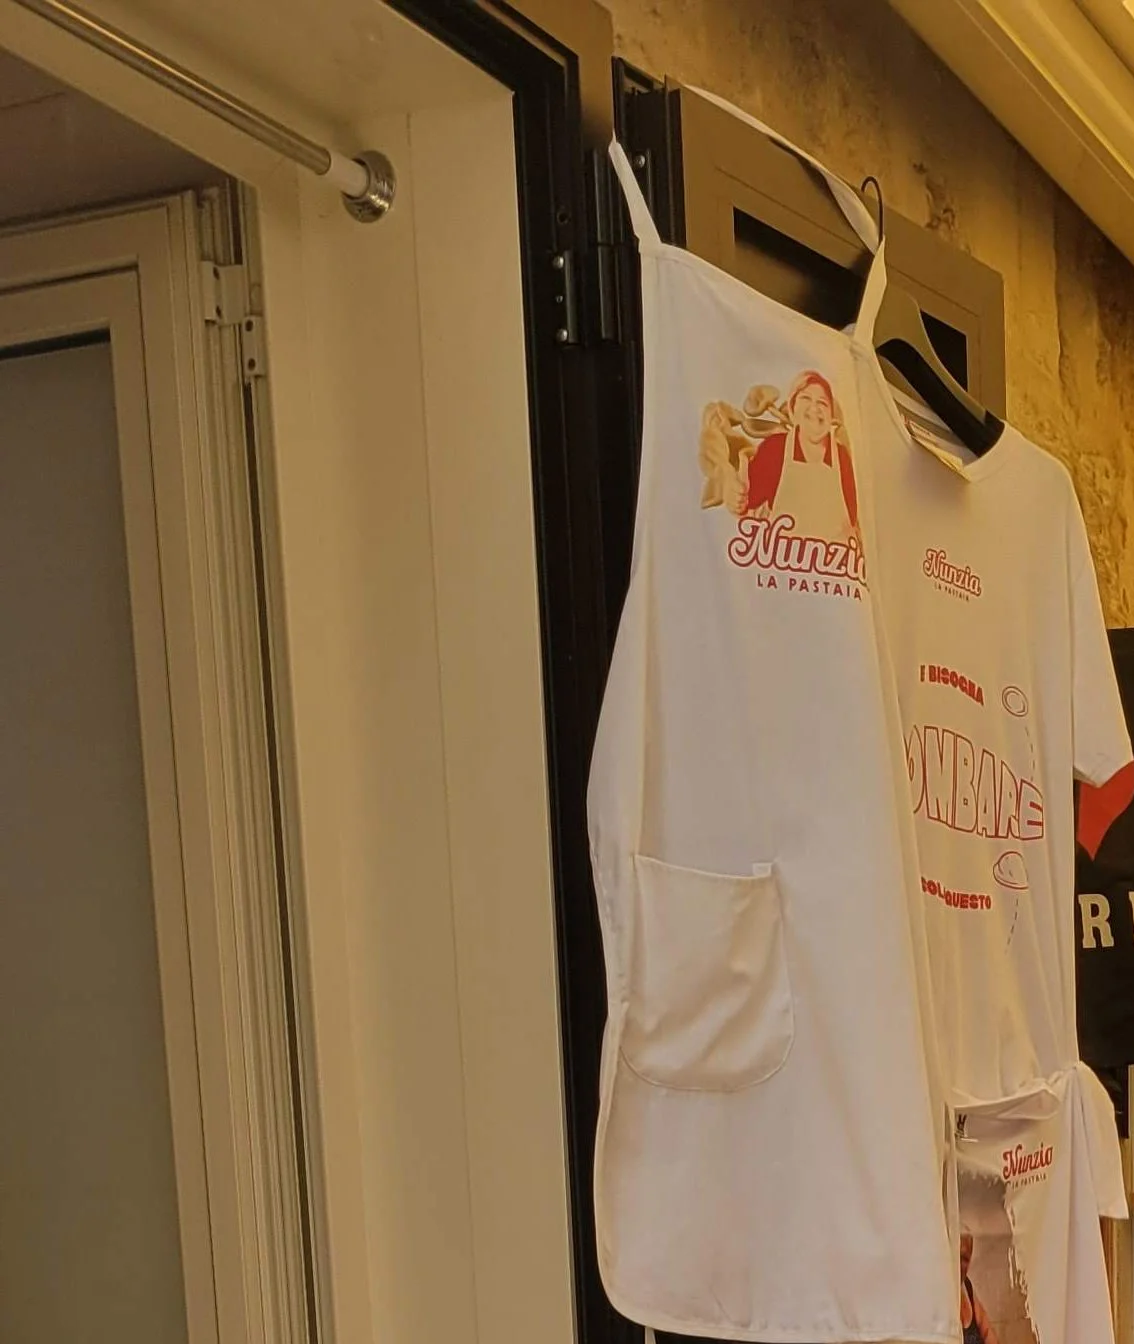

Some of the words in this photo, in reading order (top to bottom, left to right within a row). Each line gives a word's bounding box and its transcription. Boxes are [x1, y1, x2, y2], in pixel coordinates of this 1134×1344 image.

[757, 574, 777, 589] LA
[789, 577, 861, 601] PASTAIA
[923, 548, 981, 597] Nunzia
[903, 725, 1043, 840] OMBARE
[945, 889, 992, 910] QUESTO
[1002, 1142, 1054, 1180] Nunzia
